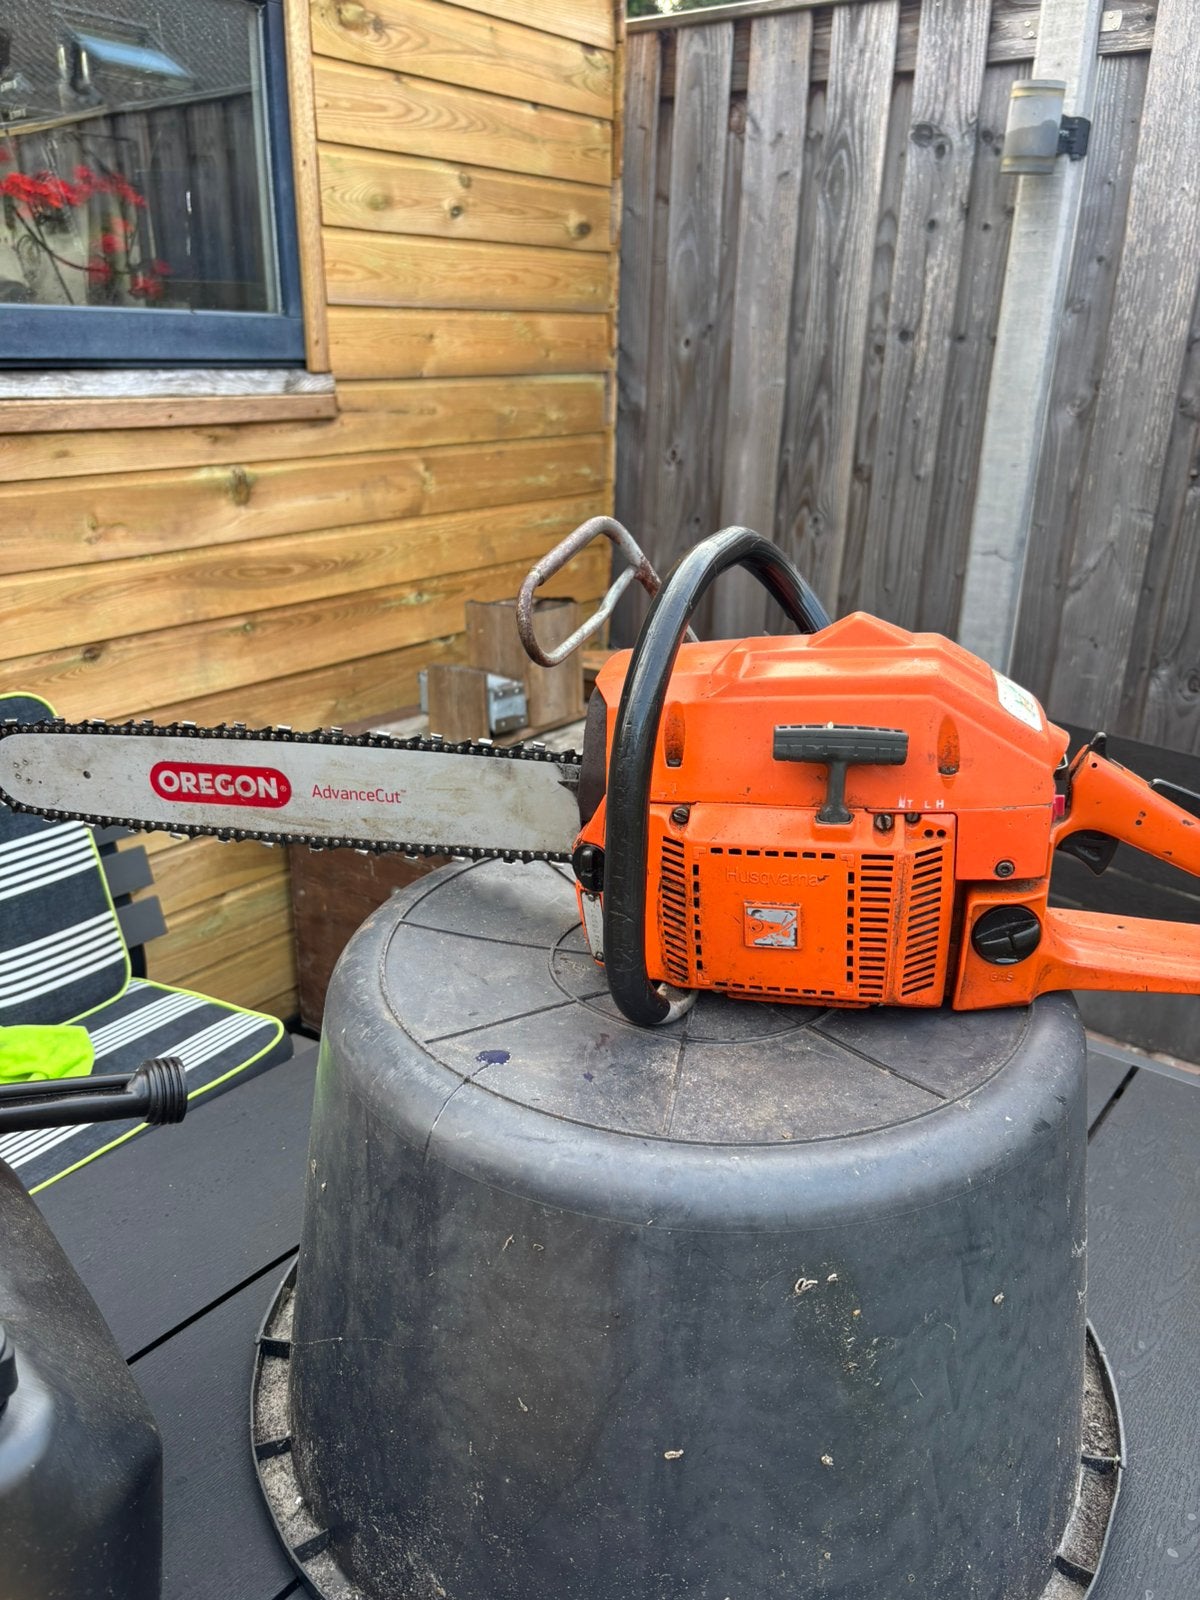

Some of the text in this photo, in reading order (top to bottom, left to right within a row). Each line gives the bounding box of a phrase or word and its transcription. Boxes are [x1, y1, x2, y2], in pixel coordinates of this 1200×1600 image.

[157, 769, 280, 800] OREGON
[311, 784, 402, 804] AdvanceCut
[725, 866, 819, 888] Husqvarna
